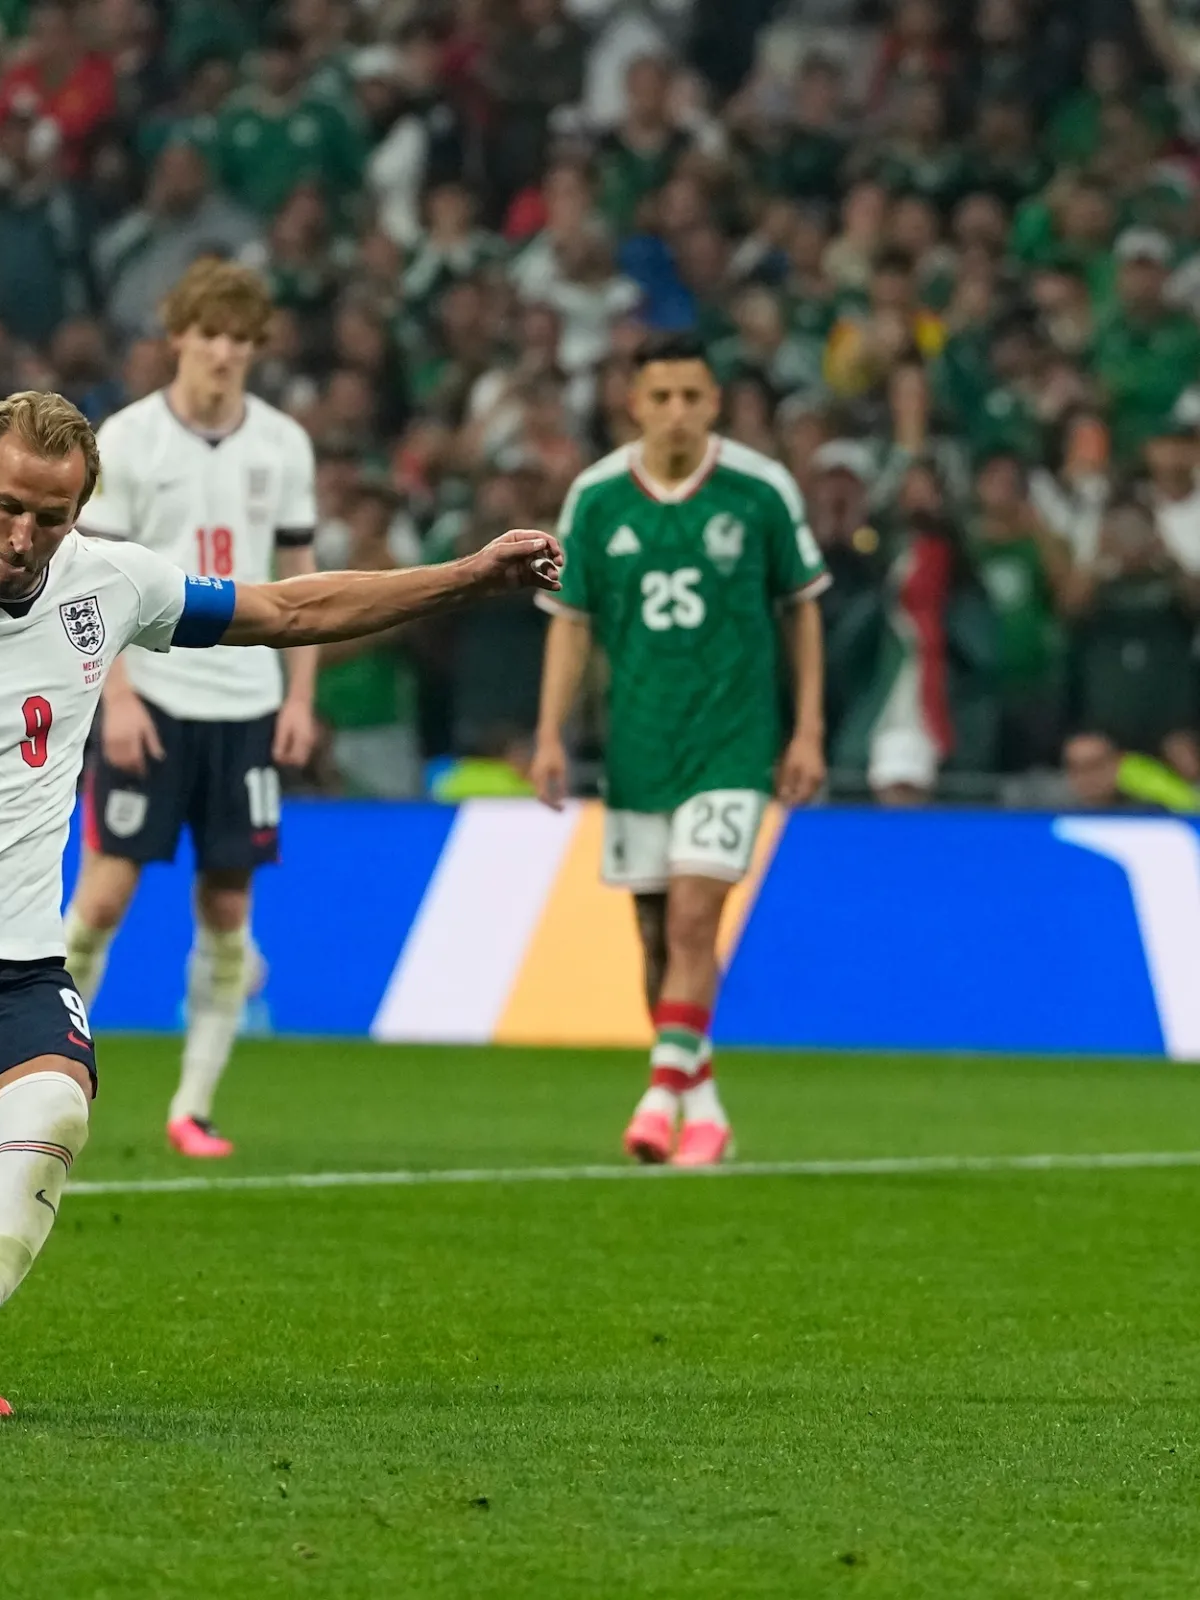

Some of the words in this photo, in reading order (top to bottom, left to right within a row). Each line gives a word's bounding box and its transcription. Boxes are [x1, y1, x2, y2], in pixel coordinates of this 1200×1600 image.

[195, 527, 233, 577] 18
[641, 567, 706, 631] 25
[20, 695, 53, 768] 9
[690, 802, 743, 850] 25
[59, 988, 92, 1040] 9
